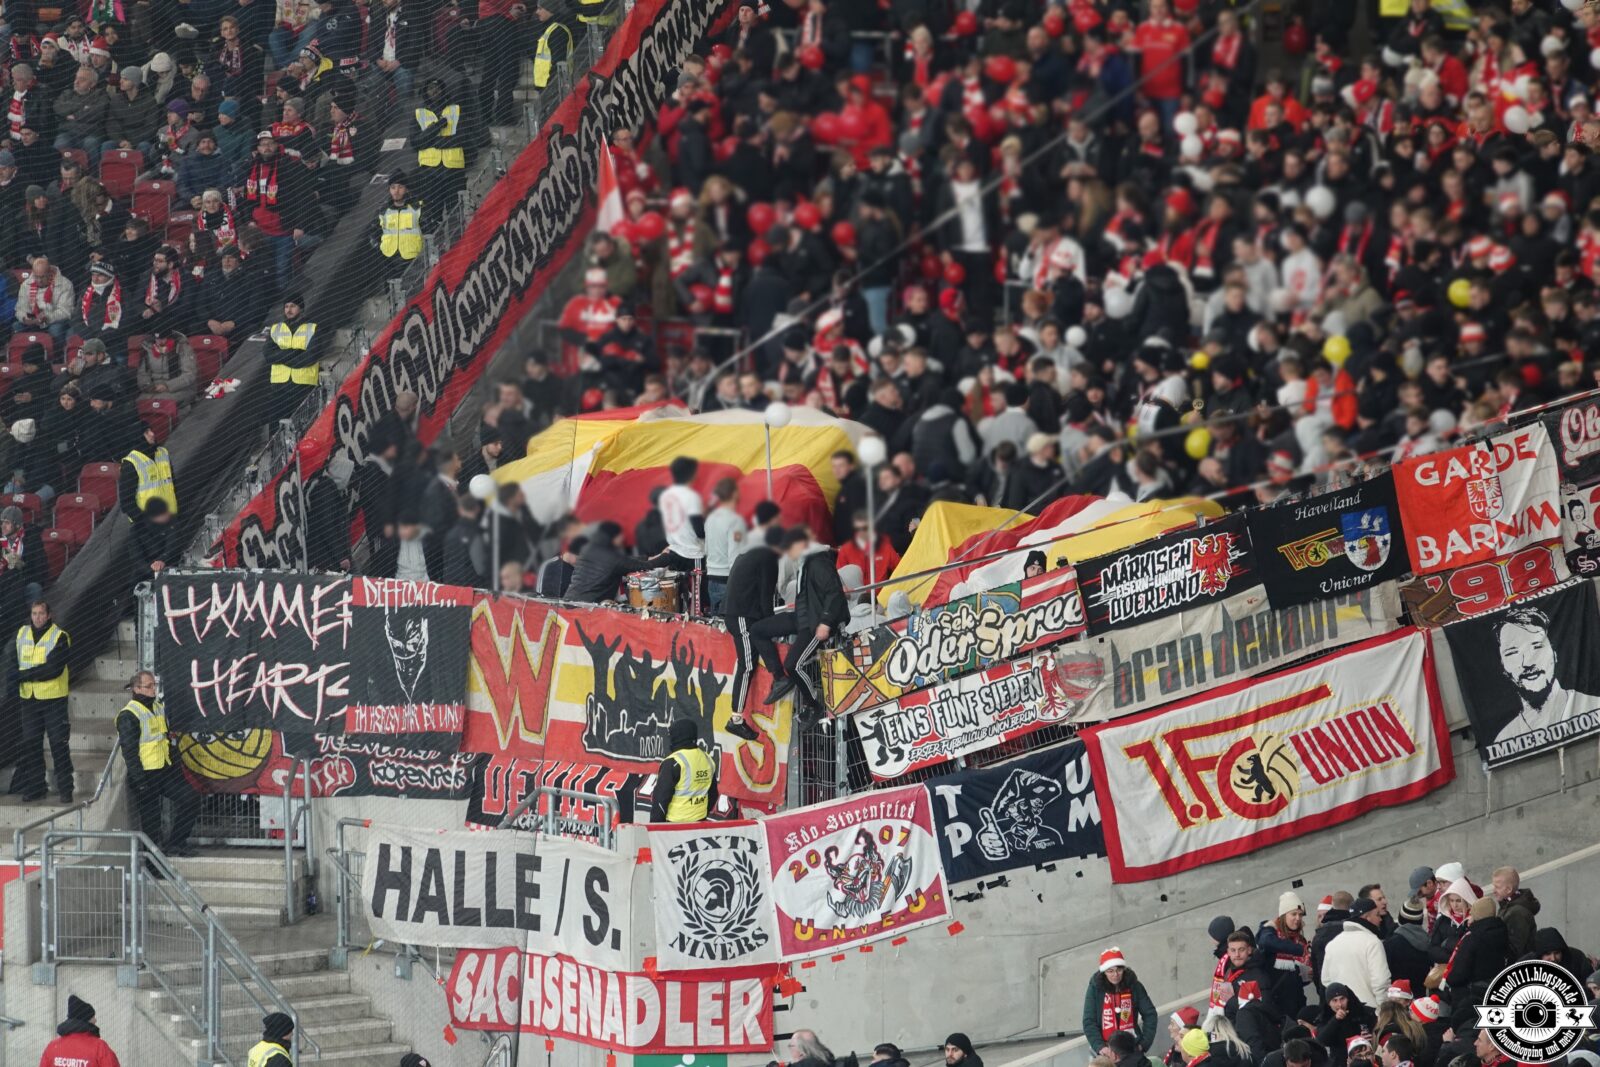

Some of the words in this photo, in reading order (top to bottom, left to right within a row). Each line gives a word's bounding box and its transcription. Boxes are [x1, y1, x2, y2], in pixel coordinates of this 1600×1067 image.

[1414, 433, 1537, 488] GARDE
[1416, 500, 1560, 569] BARNIM
[1101, 539, 1194, 595] MÄRKISCH
[1320, 572, 1375, 593] Unioner
[885, 625, 977, 687] Oder
[976, 590, 1085, 658] Spree
[880, 706, 932, 748] EINS
[929, 690, 979, 738] FÜNF
[979, 667, 1044, 715] SIEBEN
[1299, 703, 1417, 786] UNION
[1486, 730, 1548, 760] IMMER
[668, 836, 763, 864] SIXTY
[669, 927, 769, 960] NINERS
[452, 951, 767, 1047] SACHSENADLER
